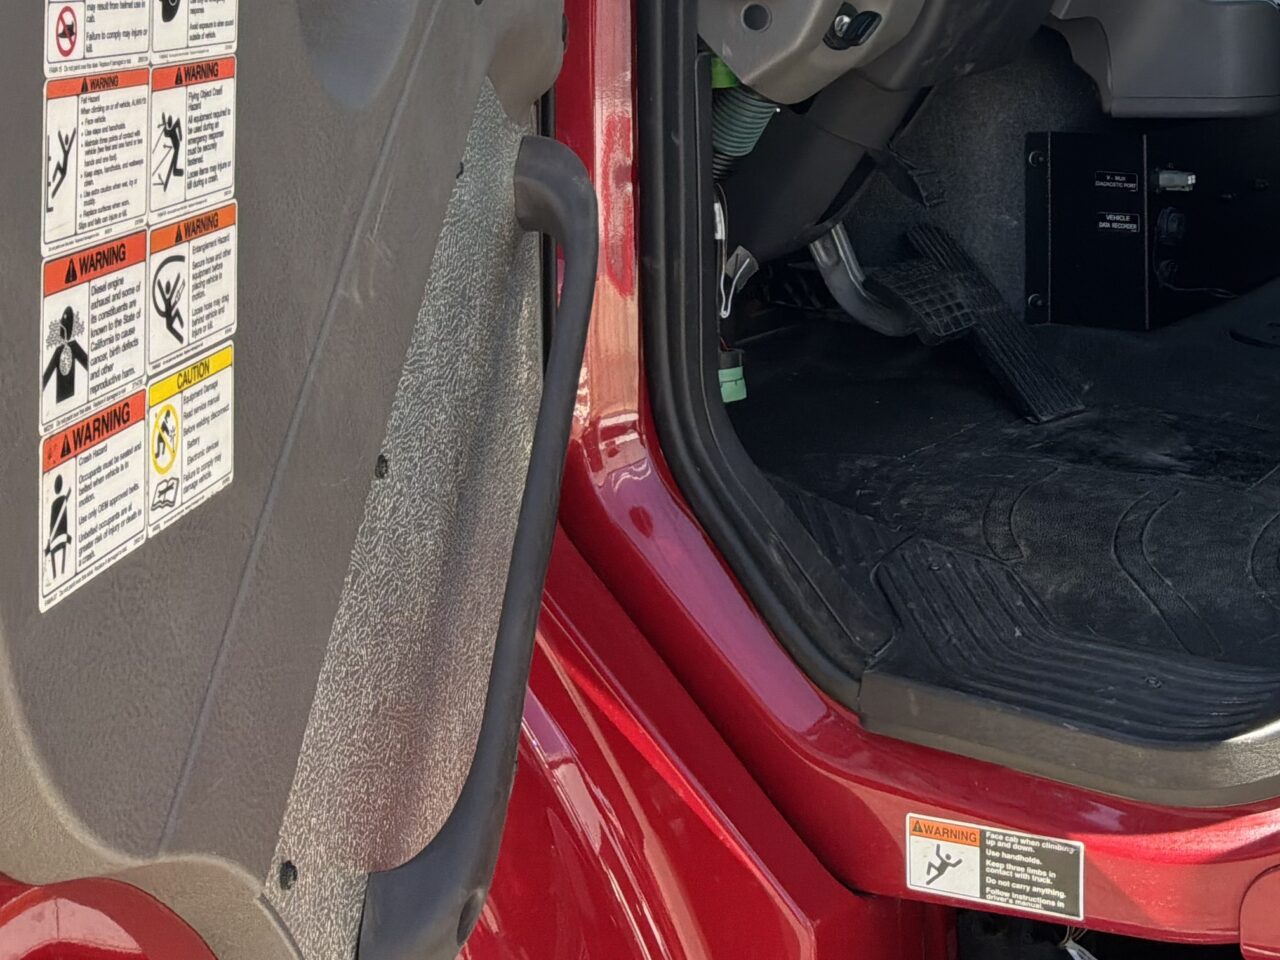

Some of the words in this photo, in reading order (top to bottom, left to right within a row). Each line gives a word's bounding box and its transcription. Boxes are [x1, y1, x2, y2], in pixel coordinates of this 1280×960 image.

[184, 62, 219, 82] WARNING
[90, 76, 119, 91] WARNING
[184, 212, 219, 239] WARNING
[1105, 214, 1131, 222] VEHICLE
[79, 243, 126, 276] WARNING
[91, 281, 107, 296] Diesel
[107, 277, 124, 291] engine
[91, 294, 111, 310] exhaust
[98, 302, 128, 321] constituents
[91, 324, 108, 339] known
[91, 336, 114, 352] California
[121, 327, 135, 339] cause
[122, 338, 139, 353] defects
[177, 358, 210, 390] CAUTION
[90, 374, 121, 396] reproductive
[72, 402, 130, 451] WARNING
[923, 823, 977, 843] WARNING
[986, 831, 1003, 841] Face
[1004, 835, 1019, 844] cab
[1019, 838, 1040, 848] when
[1041, 842, 1074, 855] climbing
[997, 840, 1011, 849] and
[1012, 843, 1035, 853] down.
[986, 848, 1000, 857] Use
[1001, 851, 1042, 865] handholds.
[986, 859, 1004, 870] Keep
[1006, 863, 1025, 873] three
[1026, 867, 1047, 877] limbs
[986, 867, 1013, 878] contact
[1014, 871, 1030, 881] with
[1031, 874, 1053, 885] truck.
[986, 886, 1010, 898] Follow
[1011, 892, 1056, 907] instructions
[1011, 882, 1031, 892] carry
[1032, 885, 1067, 900] anything.
[986, 894, 1014, 905] driver's
[1015, 899, 1044, 910] manual.
